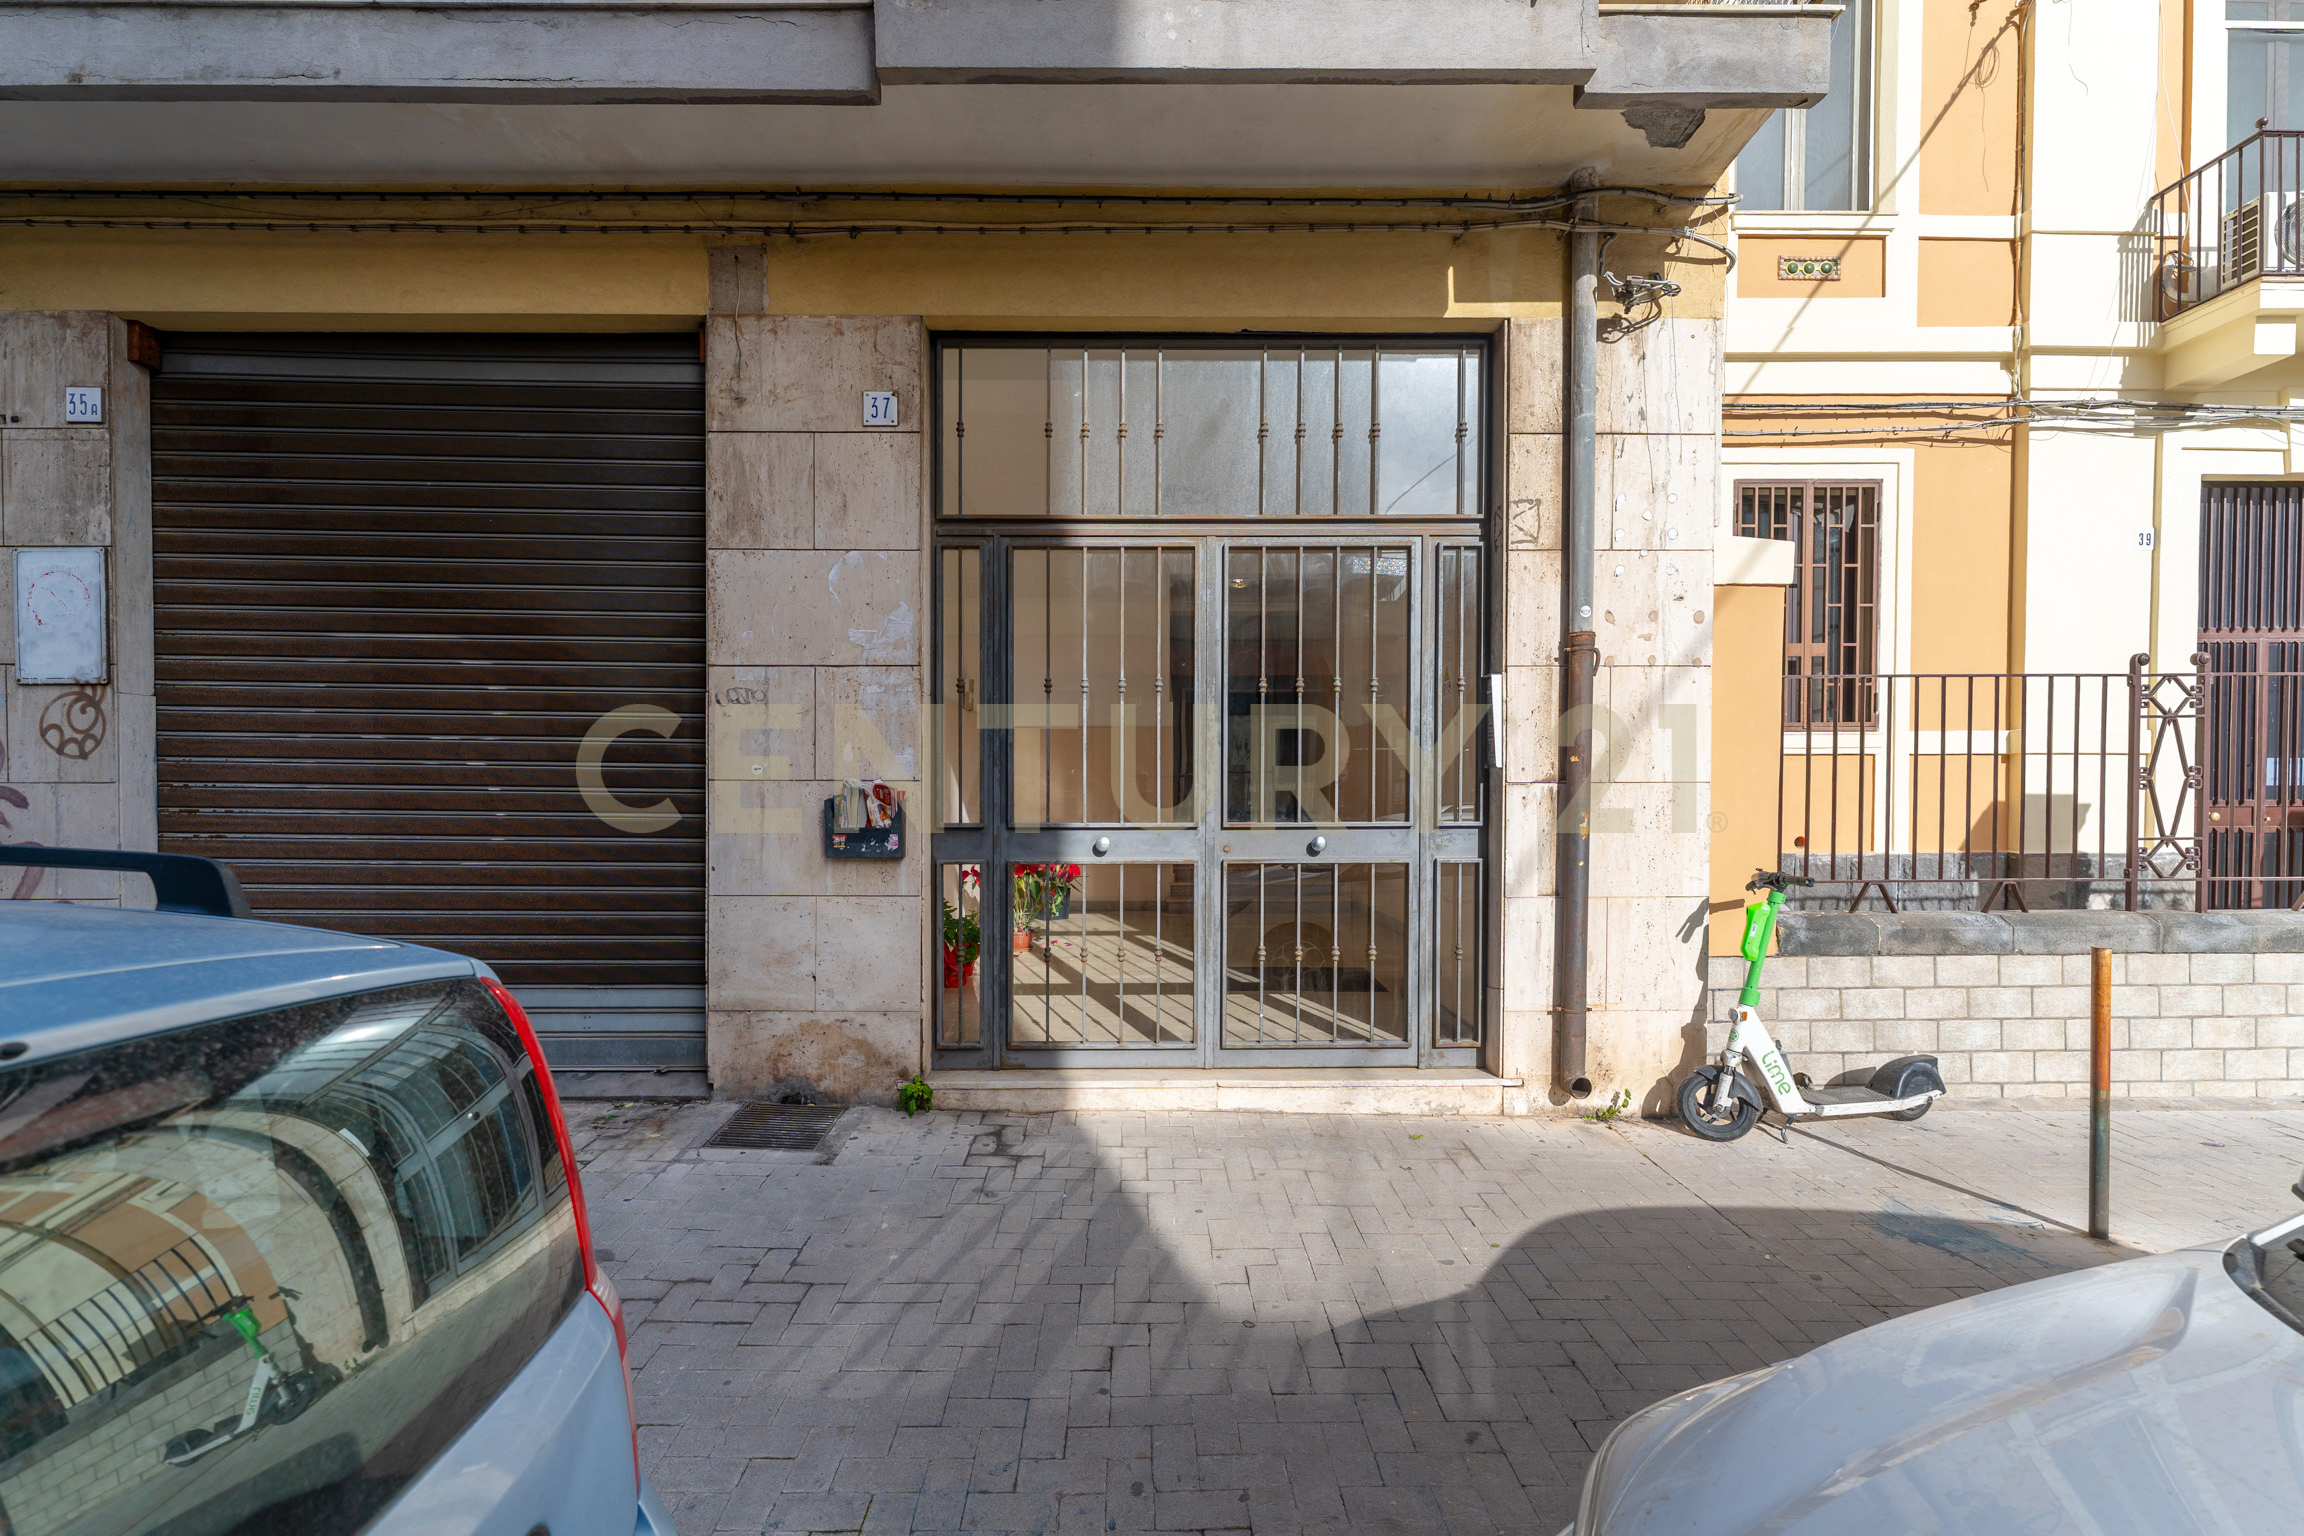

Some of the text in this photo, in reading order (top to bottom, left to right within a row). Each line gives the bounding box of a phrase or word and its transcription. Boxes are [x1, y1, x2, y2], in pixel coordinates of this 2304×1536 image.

[871, 397, 890, 419] 37
[2138, 532, 2152, 546] 39
[1761, 1050, 1791, 1095] Lime
